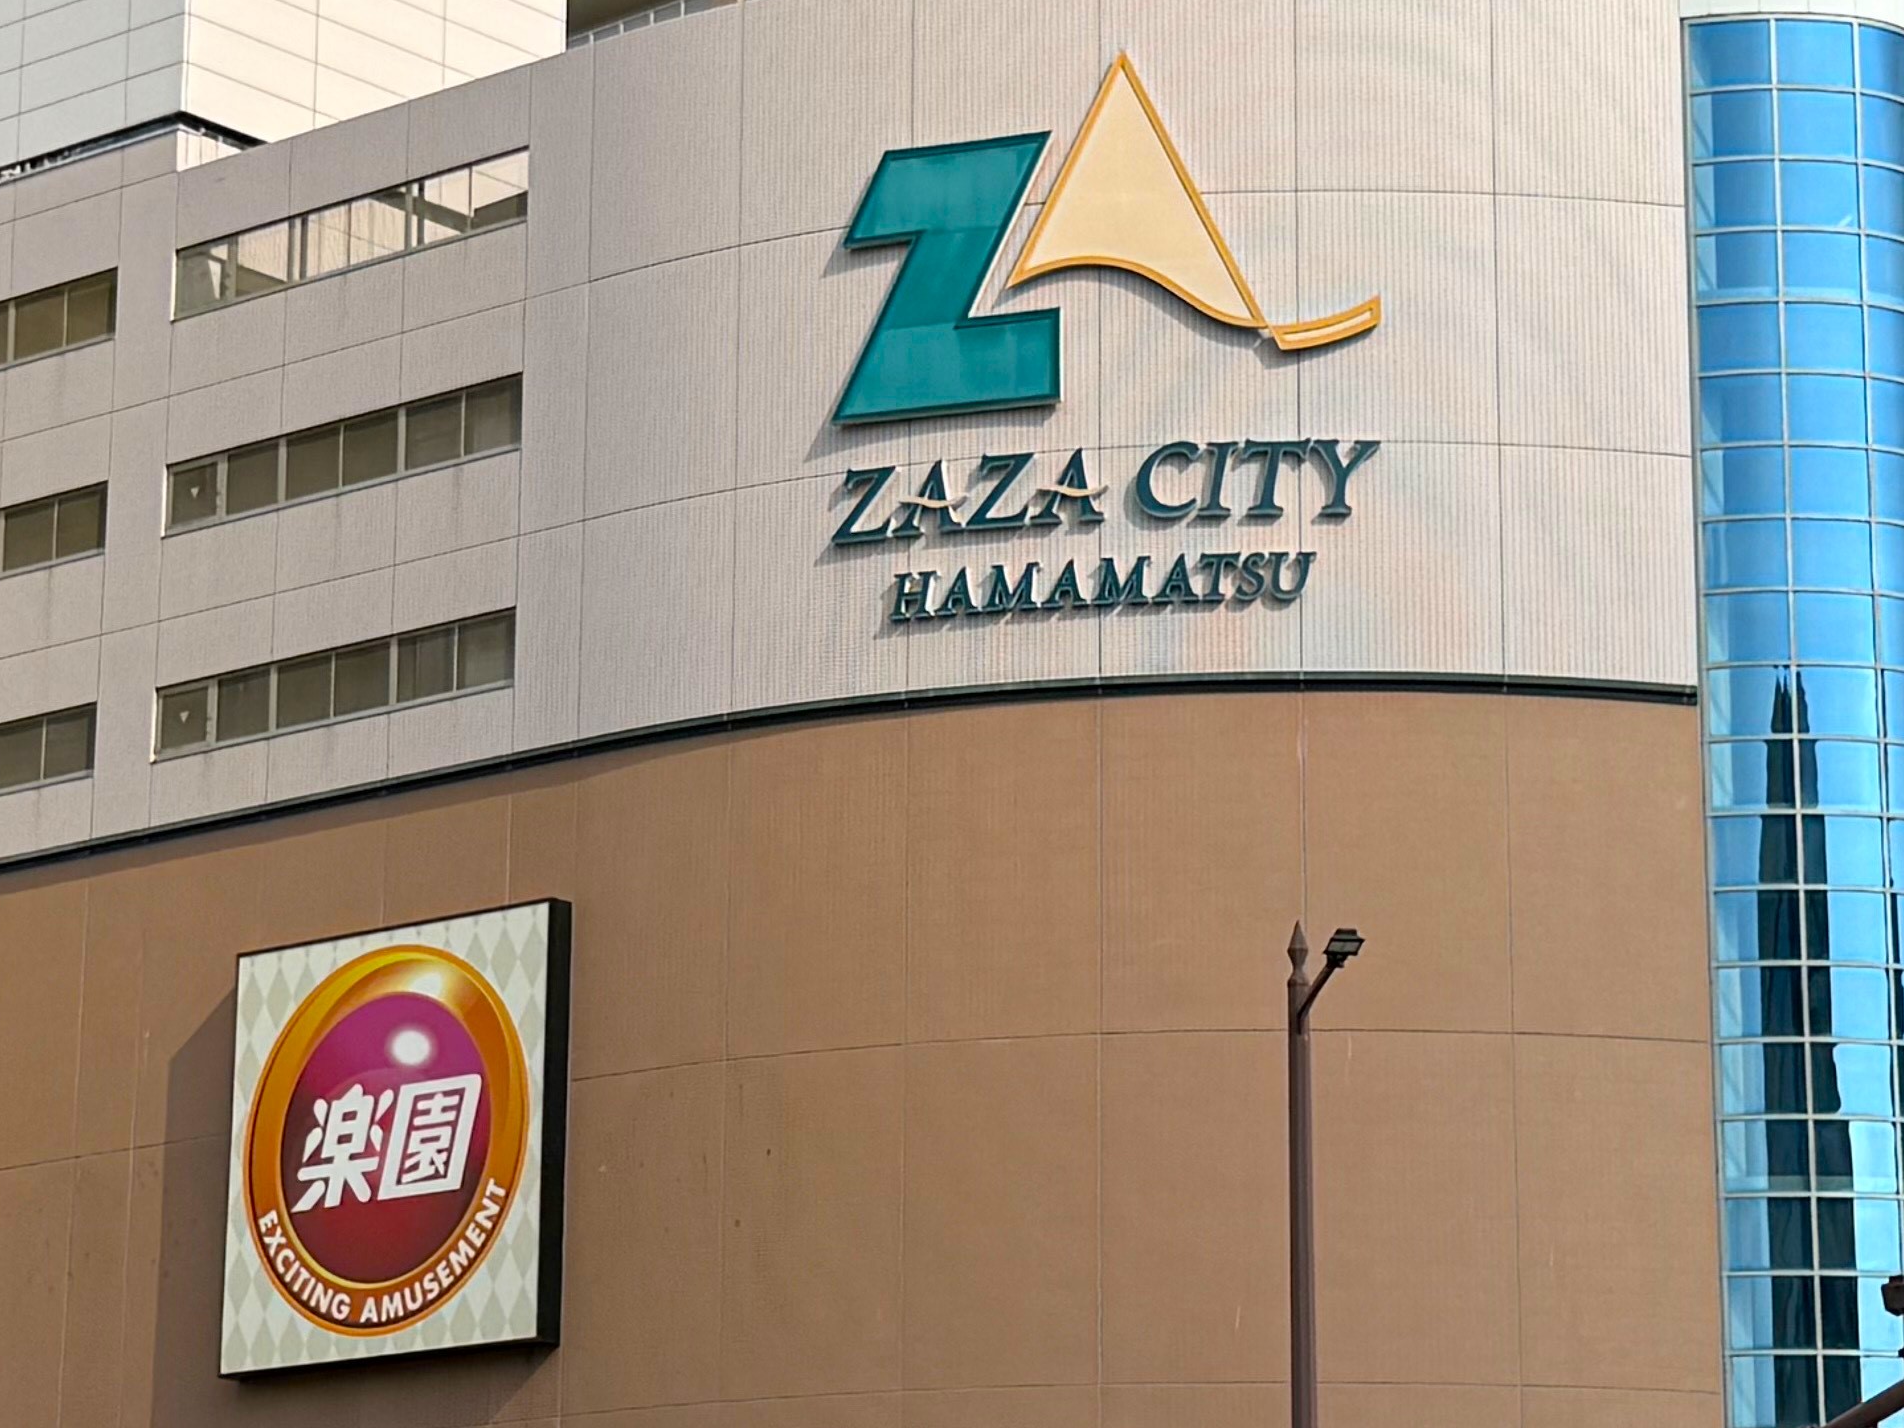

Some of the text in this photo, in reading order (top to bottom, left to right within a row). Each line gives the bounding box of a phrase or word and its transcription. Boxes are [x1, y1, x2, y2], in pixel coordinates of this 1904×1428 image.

[833, 439, 1381, 546] ZAZA CITY
[890, 552, 1317, 622] HAMAMATSU
[291, 1073, 482, 1213] 楽園
[256, 1178, 510, 1325] EXCITING AMUSEMENT
